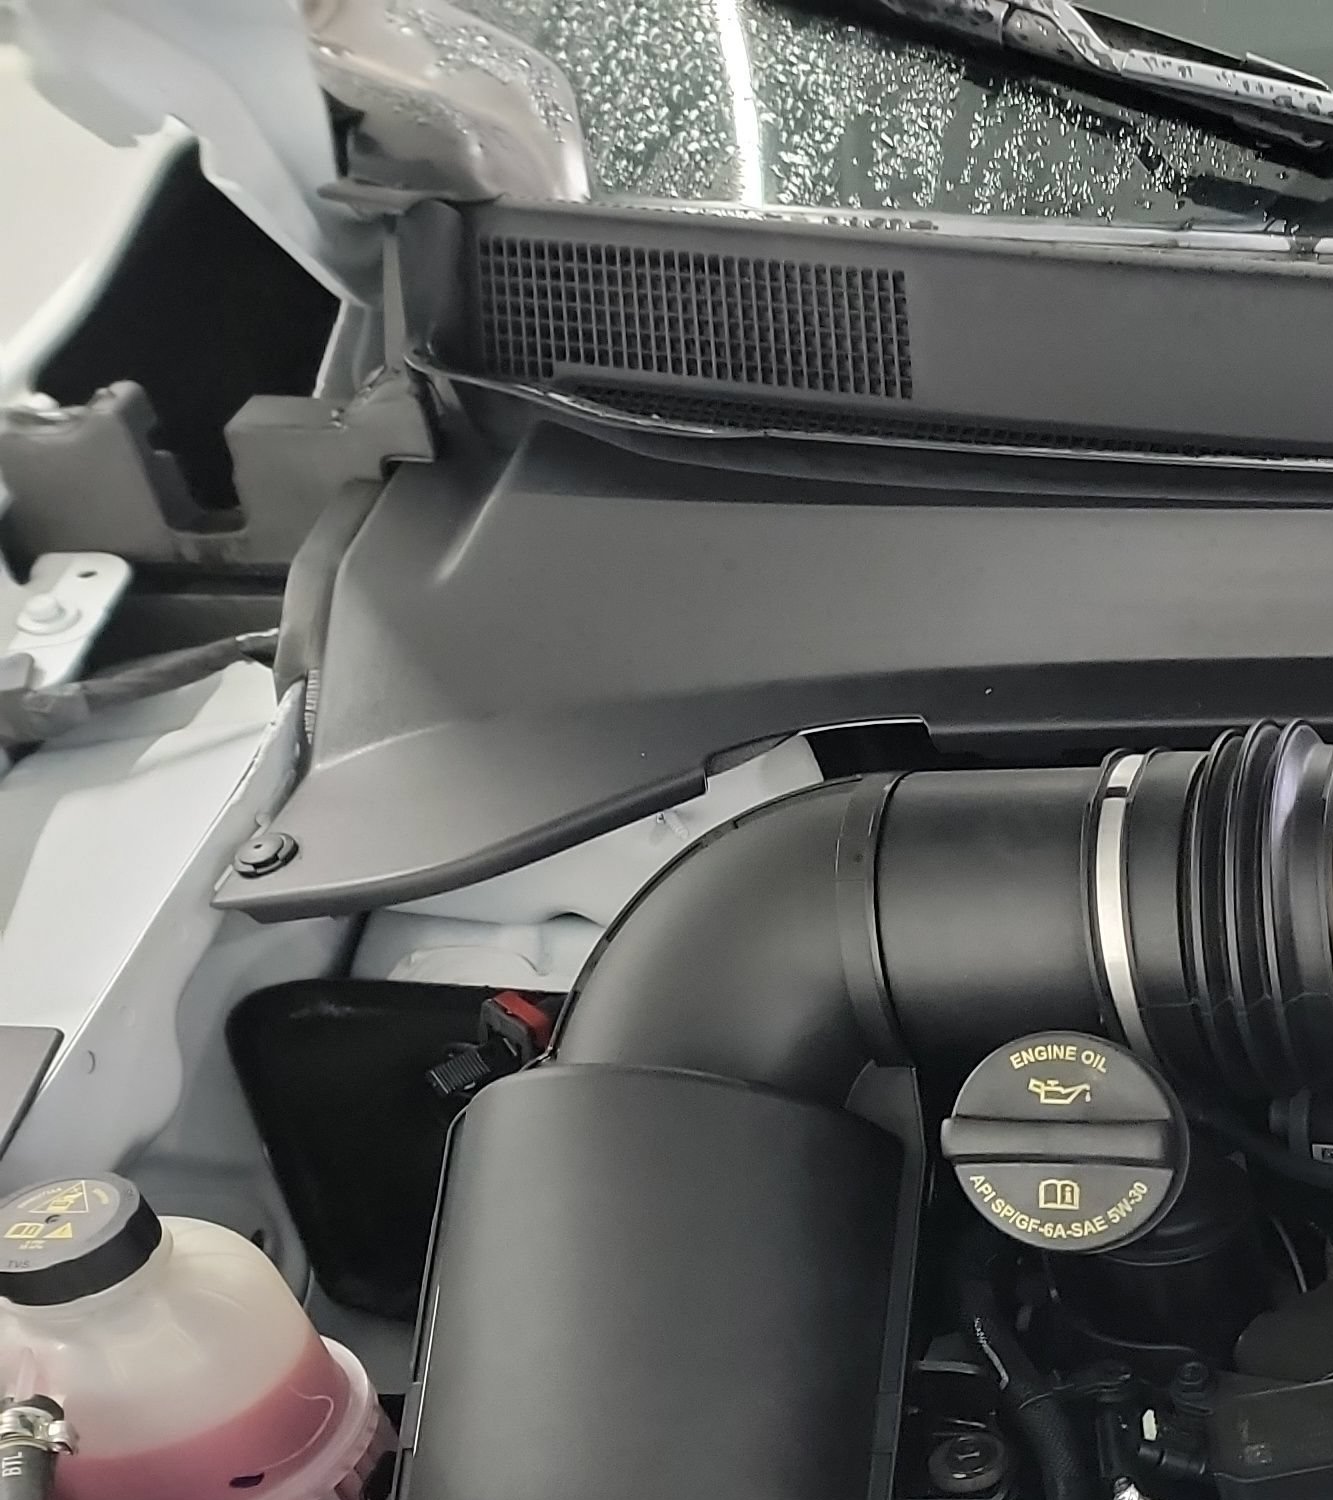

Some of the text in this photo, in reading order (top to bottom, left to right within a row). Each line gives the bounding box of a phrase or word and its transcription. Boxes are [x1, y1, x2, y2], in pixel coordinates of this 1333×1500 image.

[1009, 1044, 1109, 1073] ENGINE OIL
[969, 1173, 996, 1203] API
[1106, 1181, 1148, 1225] 5W-30
[2, 1451, 25, 1478] BTL
